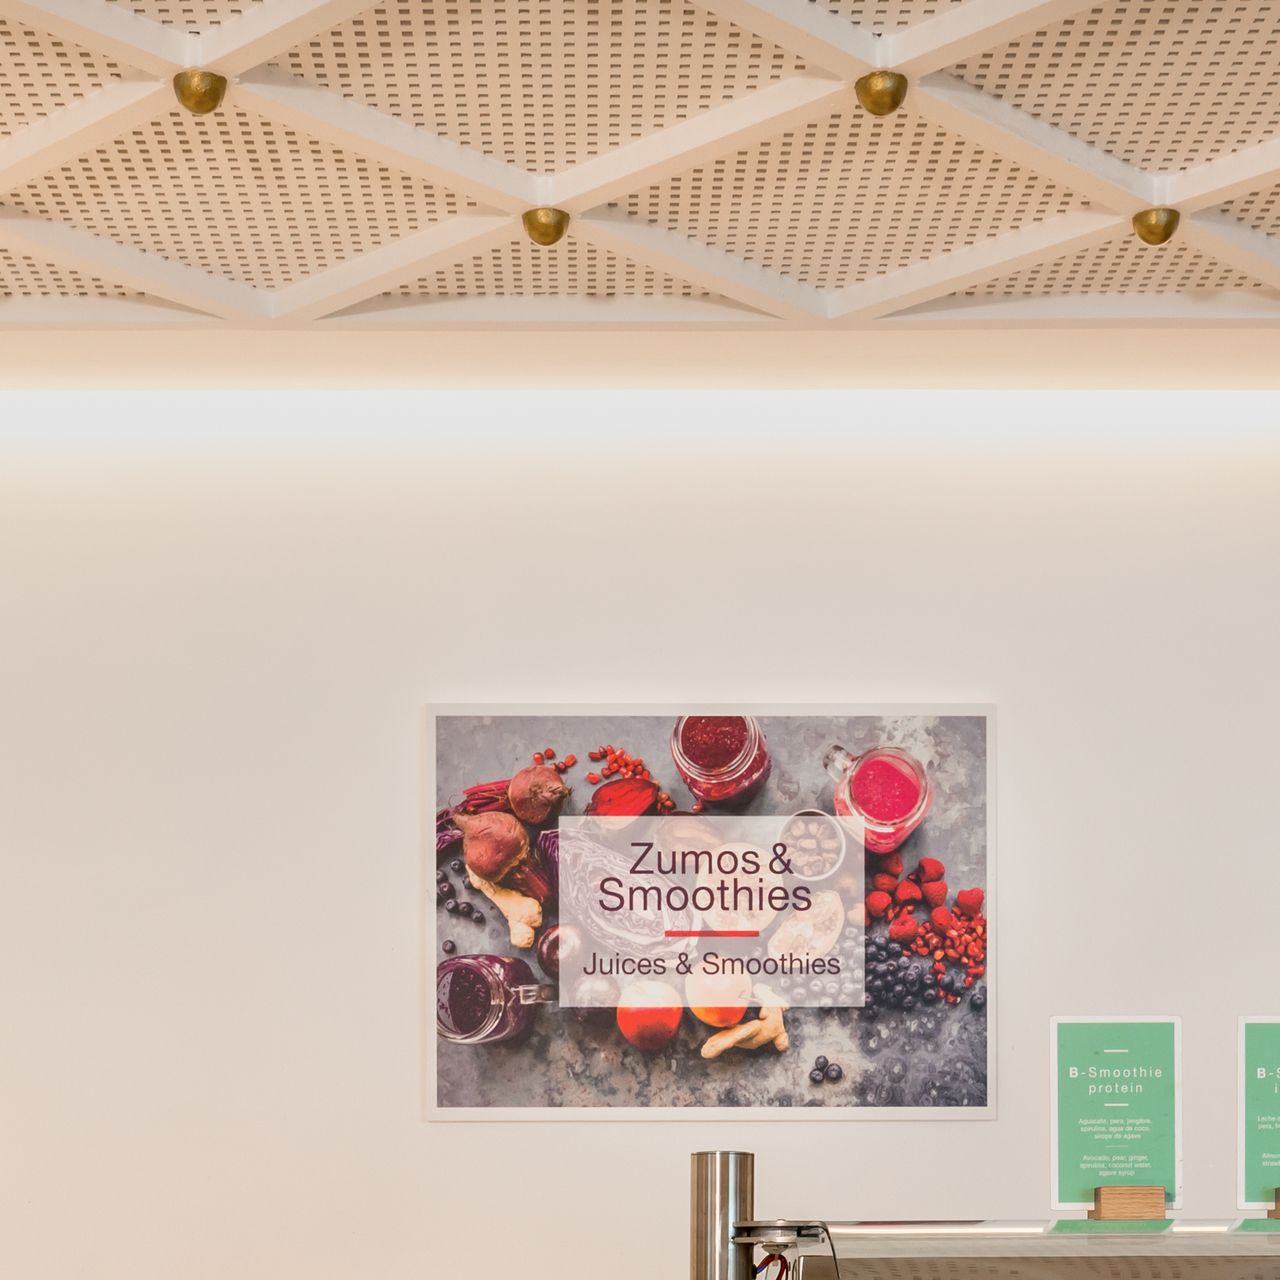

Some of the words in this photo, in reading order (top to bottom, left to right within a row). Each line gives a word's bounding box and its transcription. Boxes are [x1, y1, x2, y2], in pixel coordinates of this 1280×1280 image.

[629, 843, 760, 875] Zumos
[769, 843, 793, 875] &
[598, 878, 812, 911] Smoothies
[583, 952, 667, 975] Juices
[675, 952, 694, 975] &
[702, 952, 841, 975] Smoothies
[1088, 1083, 1143, 1095] protein
